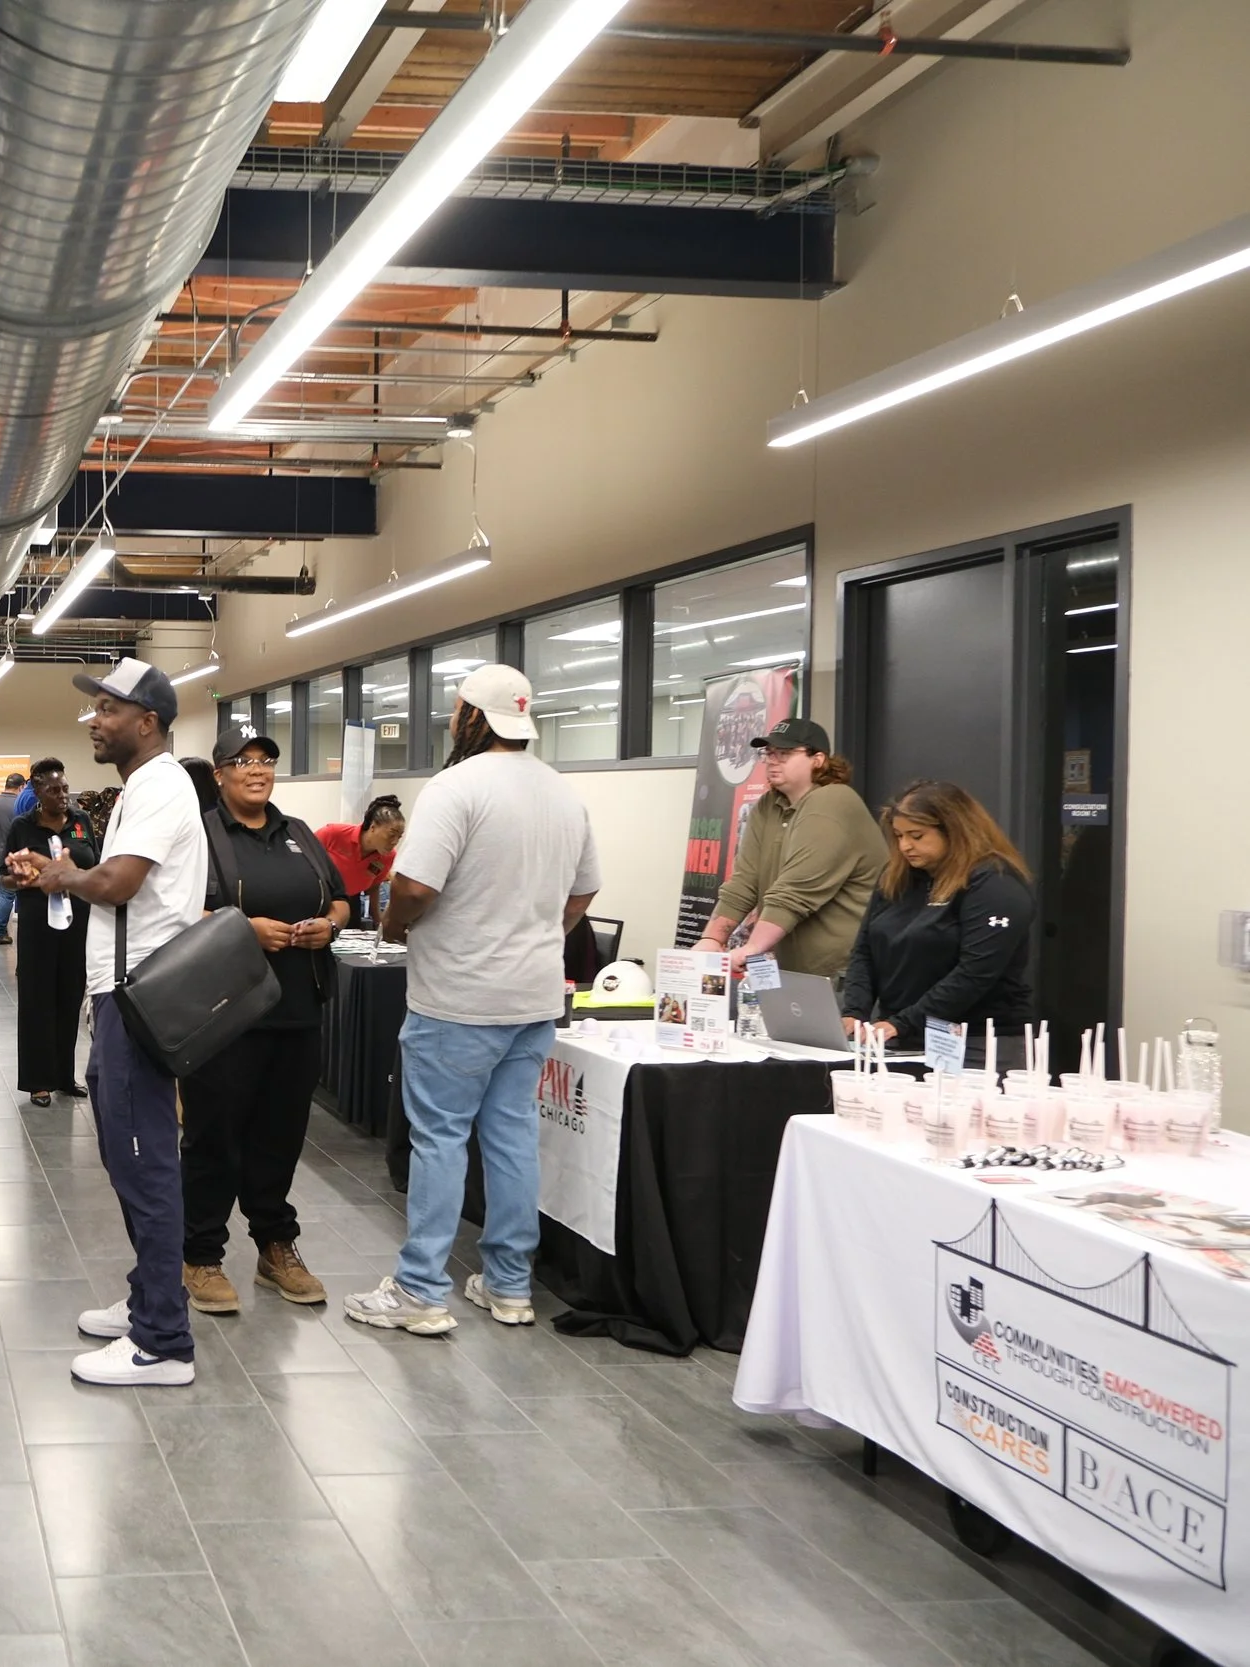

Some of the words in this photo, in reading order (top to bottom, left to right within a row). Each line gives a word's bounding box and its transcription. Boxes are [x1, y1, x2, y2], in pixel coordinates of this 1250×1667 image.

[383, 725, 397, 736] EXIT
[686, 839, 721, 874] MEN
[539, 1104, 586, 1135] CHICAGO
[973, 1350, 1001, 1375] CEC
[993, 1320, 1099, 1384] COMMUNITIES
[1103, 1370, 1223, 1441] EMPOWERED
[945, 1379, 1050, 1450] CONSTRUCTION
[1006, 1345, 1075, 1390] THROUGH
[1078, 1382, 1210, 1455] CONSTRUCTION
[969, 1414, 1050, 1476] CARES
